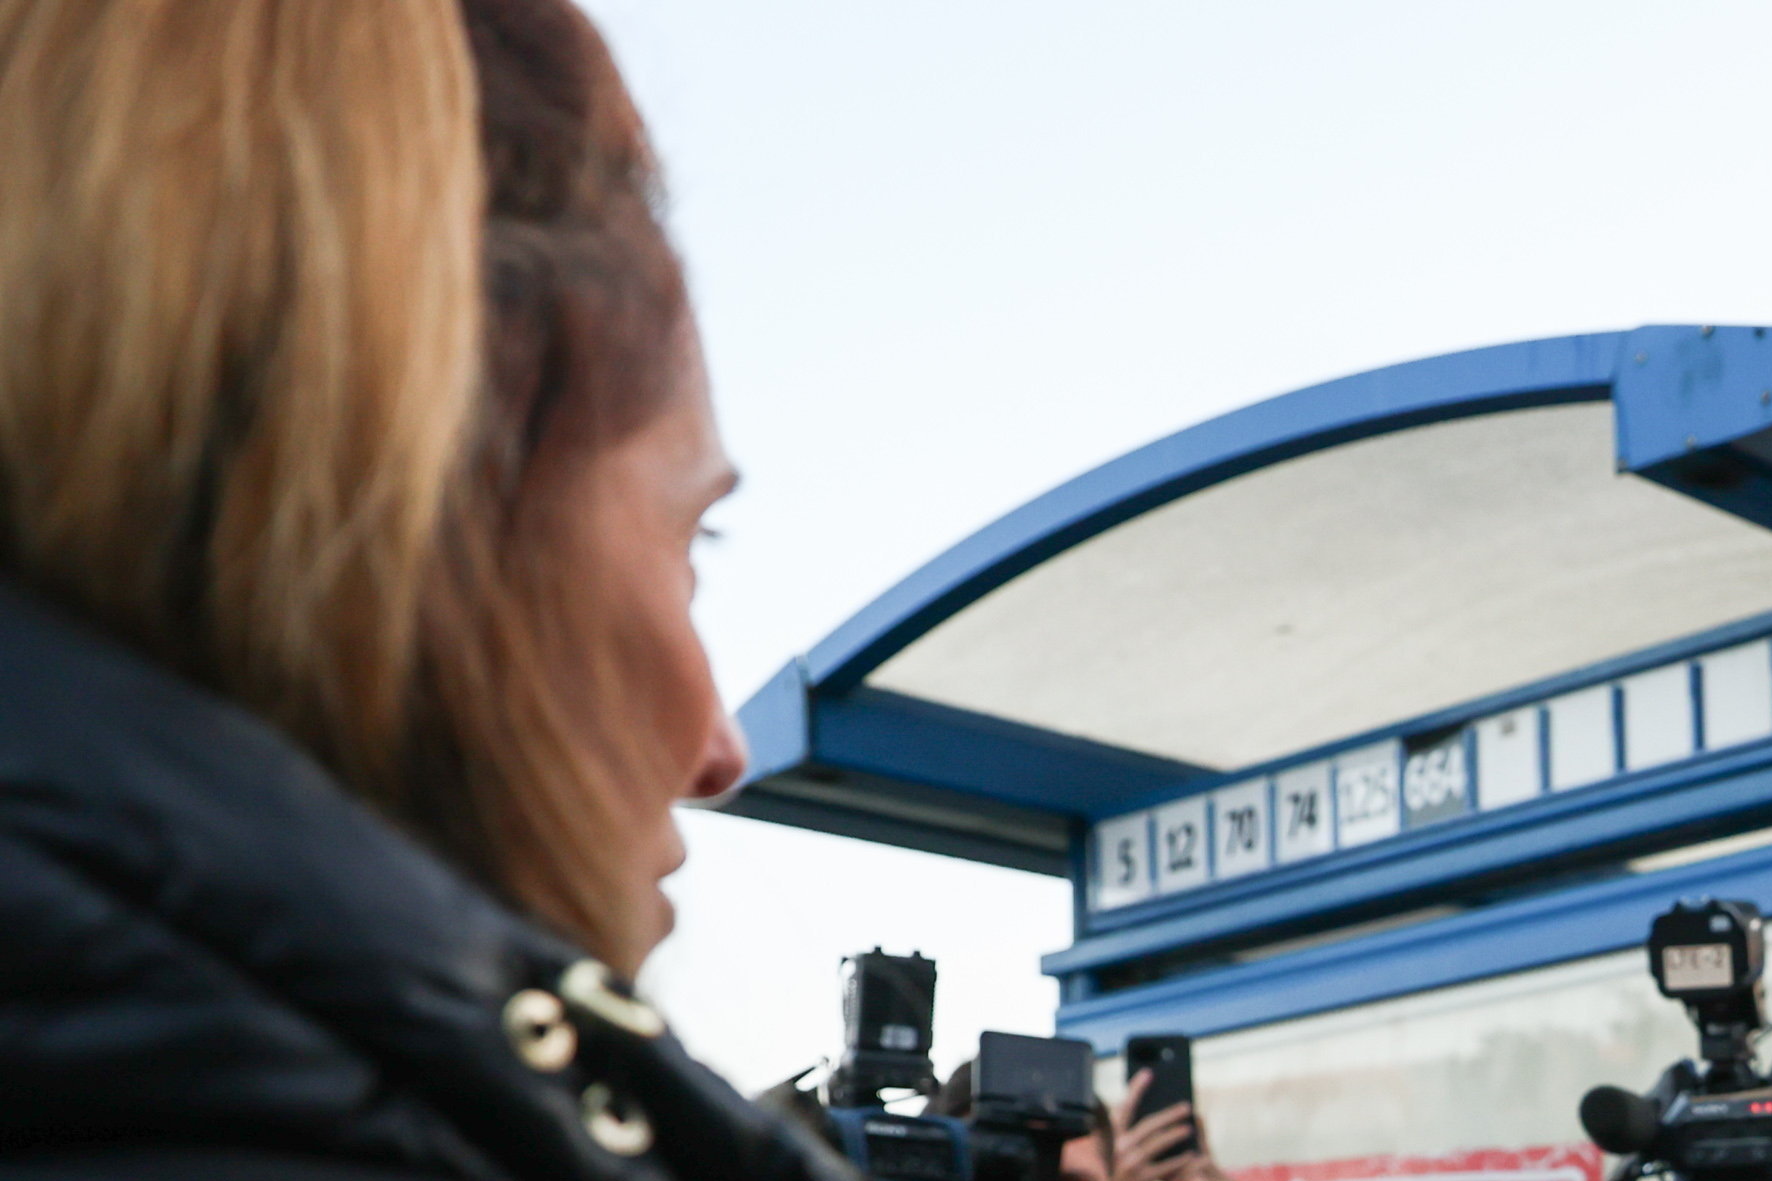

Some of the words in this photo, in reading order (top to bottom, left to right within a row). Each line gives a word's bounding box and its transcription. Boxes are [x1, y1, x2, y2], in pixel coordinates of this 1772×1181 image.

[1118, 837, 1137, 886] 5
[1167, 822, 1198, 874] 12
[1226, 804, 1260, 856] 70
[1287, 790, 1319, 838] 74
